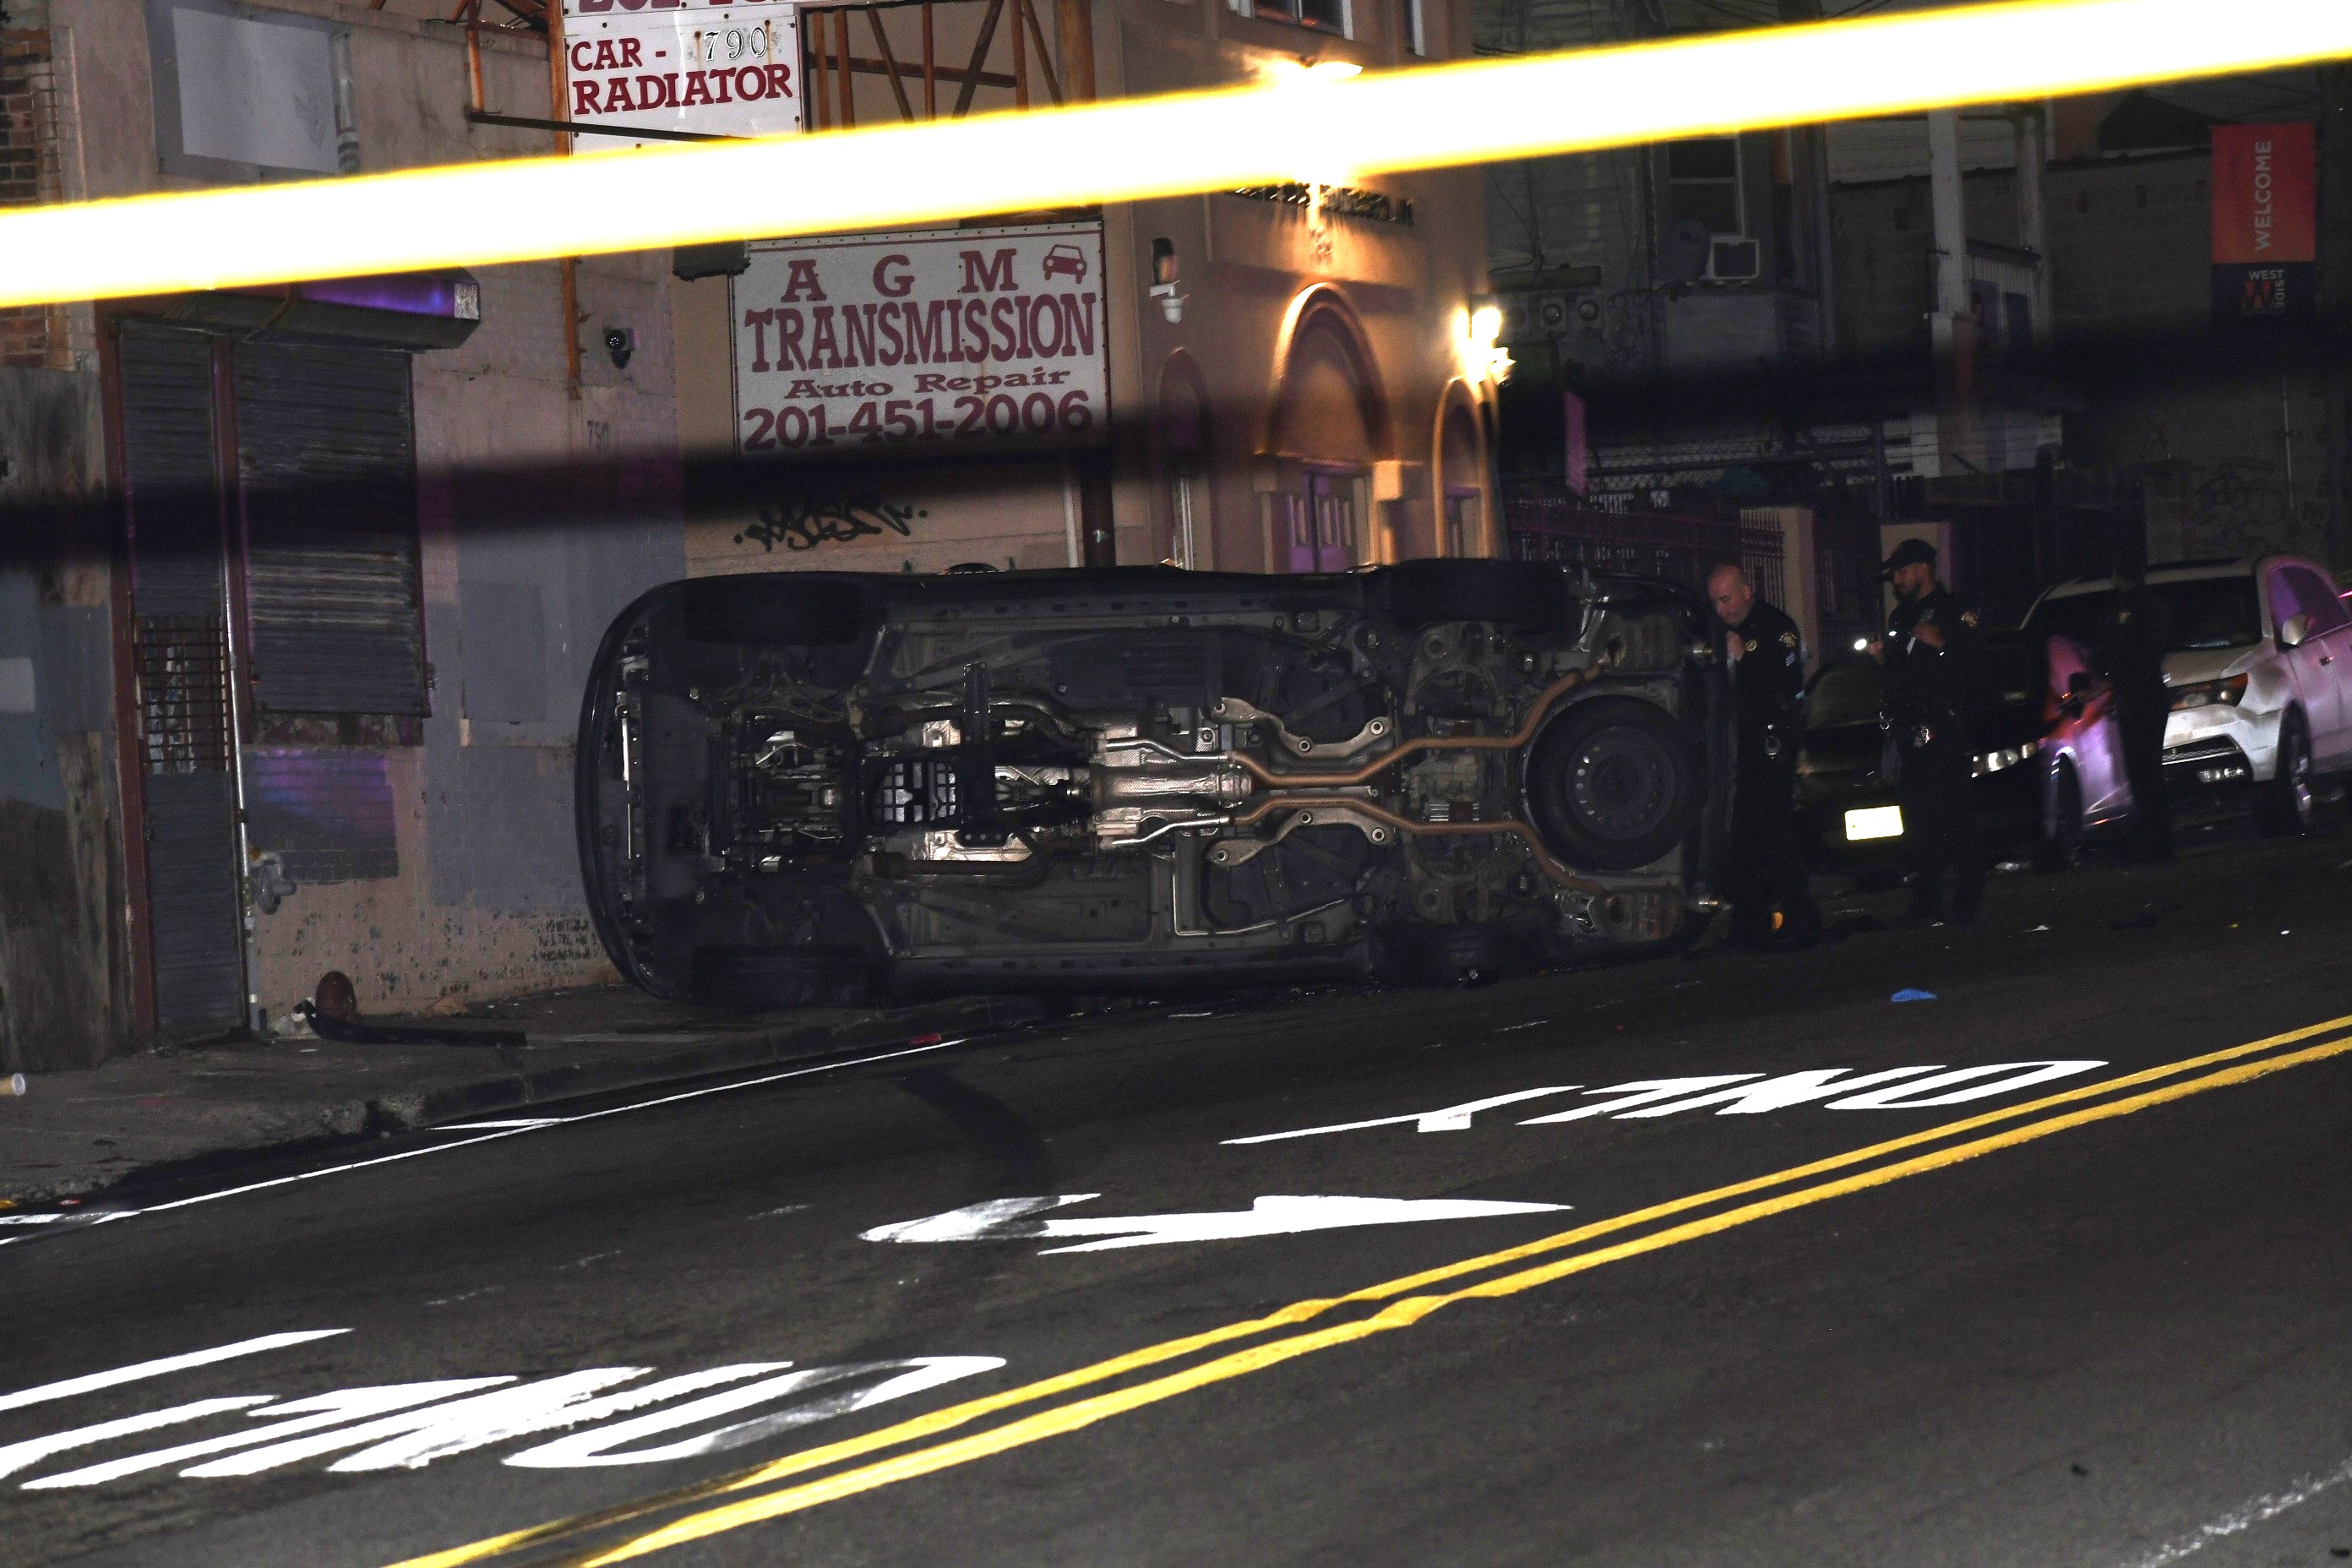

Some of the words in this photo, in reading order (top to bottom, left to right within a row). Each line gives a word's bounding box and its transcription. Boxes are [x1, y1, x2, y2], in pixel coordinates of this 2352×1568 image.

[570, 37, 643, 72] CAR
[703, 26, 767, 62] 790
[572, 63, 793, 116] RADIATOR
[2254, 140, 2272, 252] WELCOME
[781, 259, 828, 303] A
[873, 253, 916, 297] G
[959, 248, 1019, 294] M
[2248, 270, 2284, 280] WEST
[744, 292, 1097, 373] TRANSMISSION
[785, 378, 894, 400] Auto
[914, 367, 1070, 395] Repair
[743, 389, 1092, 452] 201-451-2006
